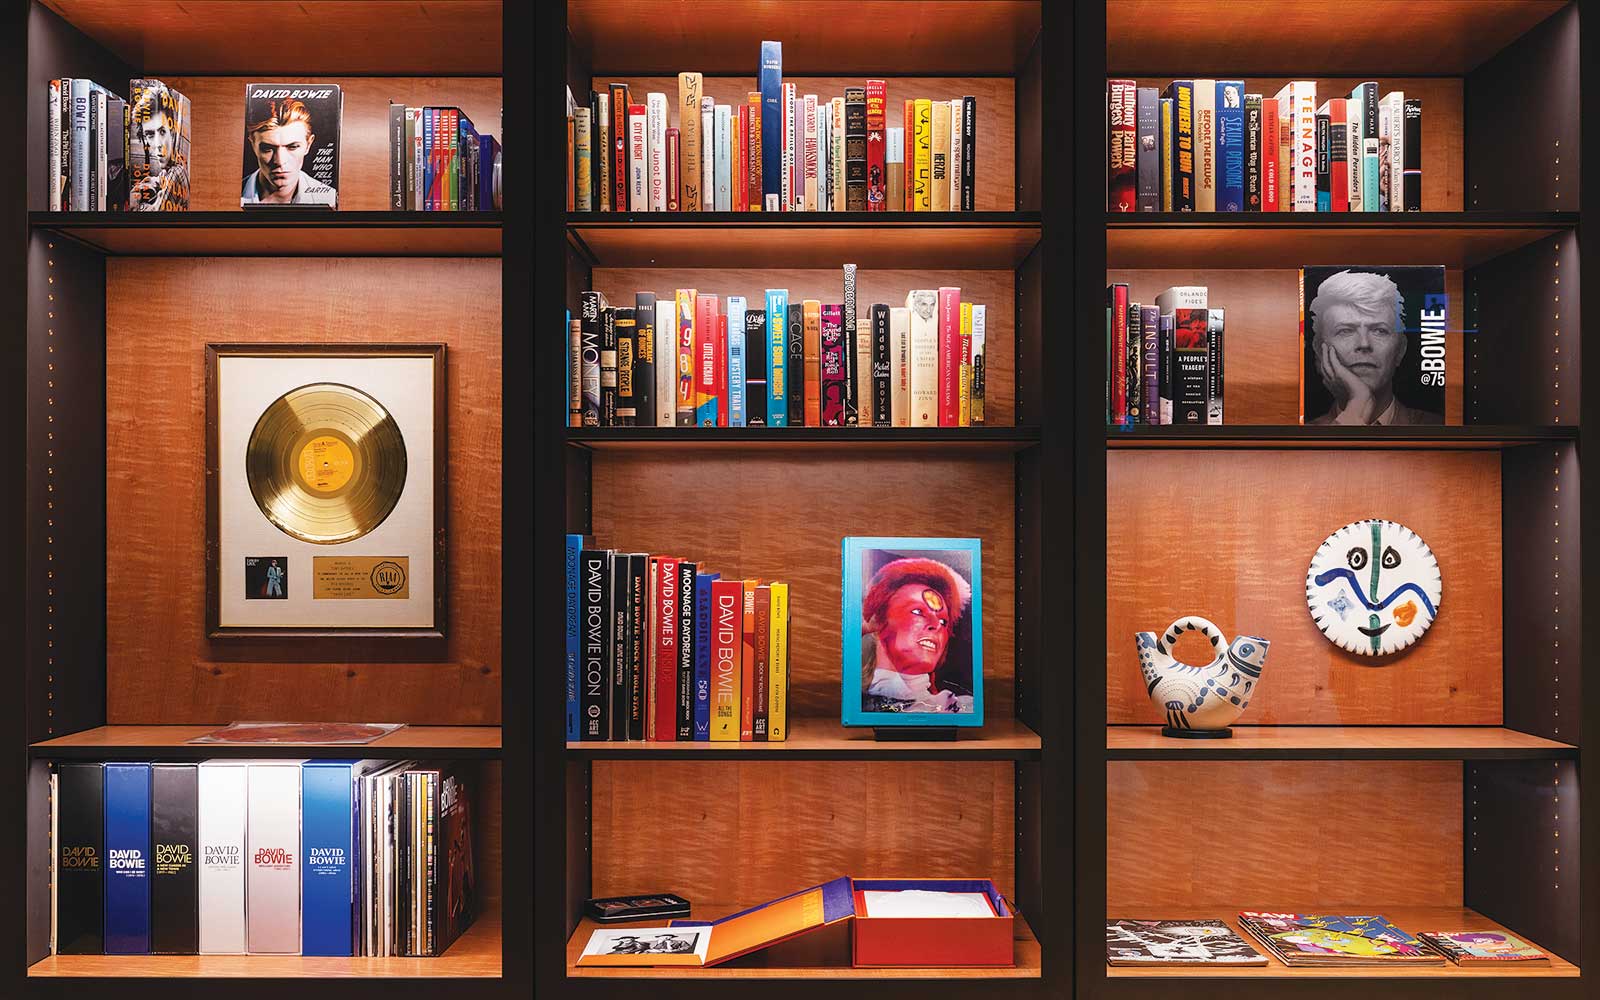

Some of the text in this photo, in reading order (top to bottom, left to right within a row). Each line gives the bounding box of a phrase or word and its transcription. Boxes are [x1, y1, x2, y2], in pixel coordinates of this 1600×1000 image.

[251, 89, 333, 99] DAVID BOWIE
[1109, 84, 1124, 126] Burgess
[1123, 84, 1136, 127] Anthony
[76, 97, 87, 131] BOWIE
[634, 122, 644, 135] CITY
[1178, 86, 1192, 174] NOWHERE TO RUN
[1303, 96, 1313, 179] TEENAGE
[312, 156, 334, 164] MAN
[316, 148, 334, 156] THE
[634, 143, 644, 161] NIGHT
[653, 148, 662, 176] Junot
[806, 137, 817, 179] HAWKSMOOR
[1111, 130, 1123, 169] Powers
[1123, 130, 1136, 168] Earthly
[1203, 110, 1212, 190] BEFORE THE DELUGE
[1226, 117, 1243, 189] SEXUAL PERSONAE
[1352, 122, 1360, 193] The Hidden Persuaders
[1393, 138, 1401, 165] PARROT
[934, 153, 946, 180] HERZOG
[304, 186, 331, 194] EARTH
[653, 179, 662, 201] Díaz
[583, 301, 591, 319] AMIS
[588, 296, 599, 323] MARTIN
[638, 329, 646, 360] OF DUNCES
[772, 317, 784, 345] SWEET
[790, 323, 802, 360] CAGE
[877, 311, 886, 359] Wonder
[1421, 309, 1445, 371] BOWIE
[582, 332, 599, 395] MONEY
[703, 342, 713, 360] LITTLE
[772, 346, 784, 367] SOUL
[1144, 324, 1157, 380] INSULT
[620, 341, 631, 393] STRANGE PEOPLE
[703, 361, 713, 385] RICHARD
[1421, 372, 1445, 386] @75
[732, 357, 741, 411] MYSTERY TRAIN
[772, 368, 784, 397] MUSIC
[662, 563, 673, 597] DAVID
[744, 591, 754, 615] BOWIE
[588, 560, 601, 695] DAVID BOWIE ICON
[662, 600, 673, 634] BOWIE
[682, 569, 691, 668] MOONAGE DAYDREAM
[662, 637, 673, 646] IS
[718, 595, 734, 704] DAVID BOWIE
[698, 680, 708, 701] 50
[63, 847, 96, 857] DAVID
[63, 857, 100, 868] BOWIE
[110, 850, 142, 859] DAVID
[157, 844, 189, 854] DAVID
[157, 854, 193, 863] BOWIE
[205, 846, 239, 855] DAVID
[205, 855, 240, 865] BOWIE
[254, 854, 293, 864] BOWIE
[309, 856, 346, 865] BOWIE
[311, 848, 344, 856] DAVID
[110, 859, 145, 869] BOWIE
